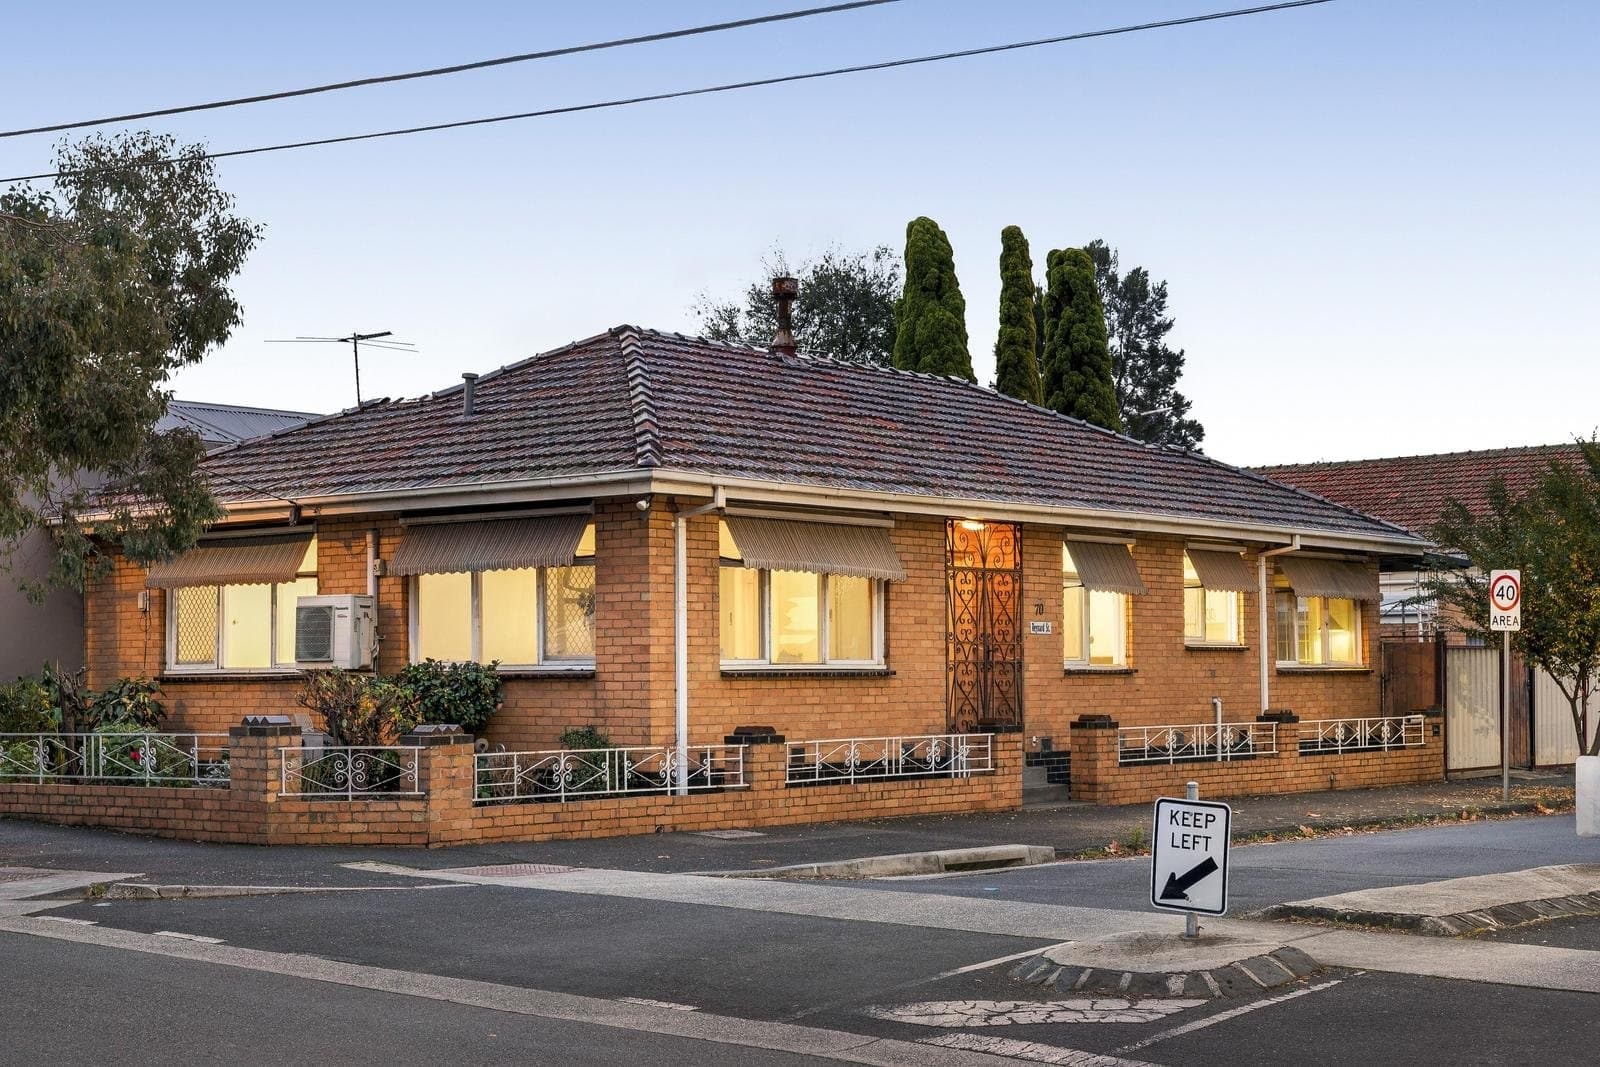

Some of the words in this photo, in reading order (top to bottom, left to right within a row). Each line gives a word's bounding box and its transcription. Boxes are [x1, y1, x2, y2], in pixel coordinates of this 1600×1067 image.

[1496, 585, 1515, 600] 40
[1034, 603, 1044, 616] 70
[1492, 615, 1519, 626] AREA
[1169, 809, 1217, 829] KEEP
[1171, 832, 1212, 852] LEFT
